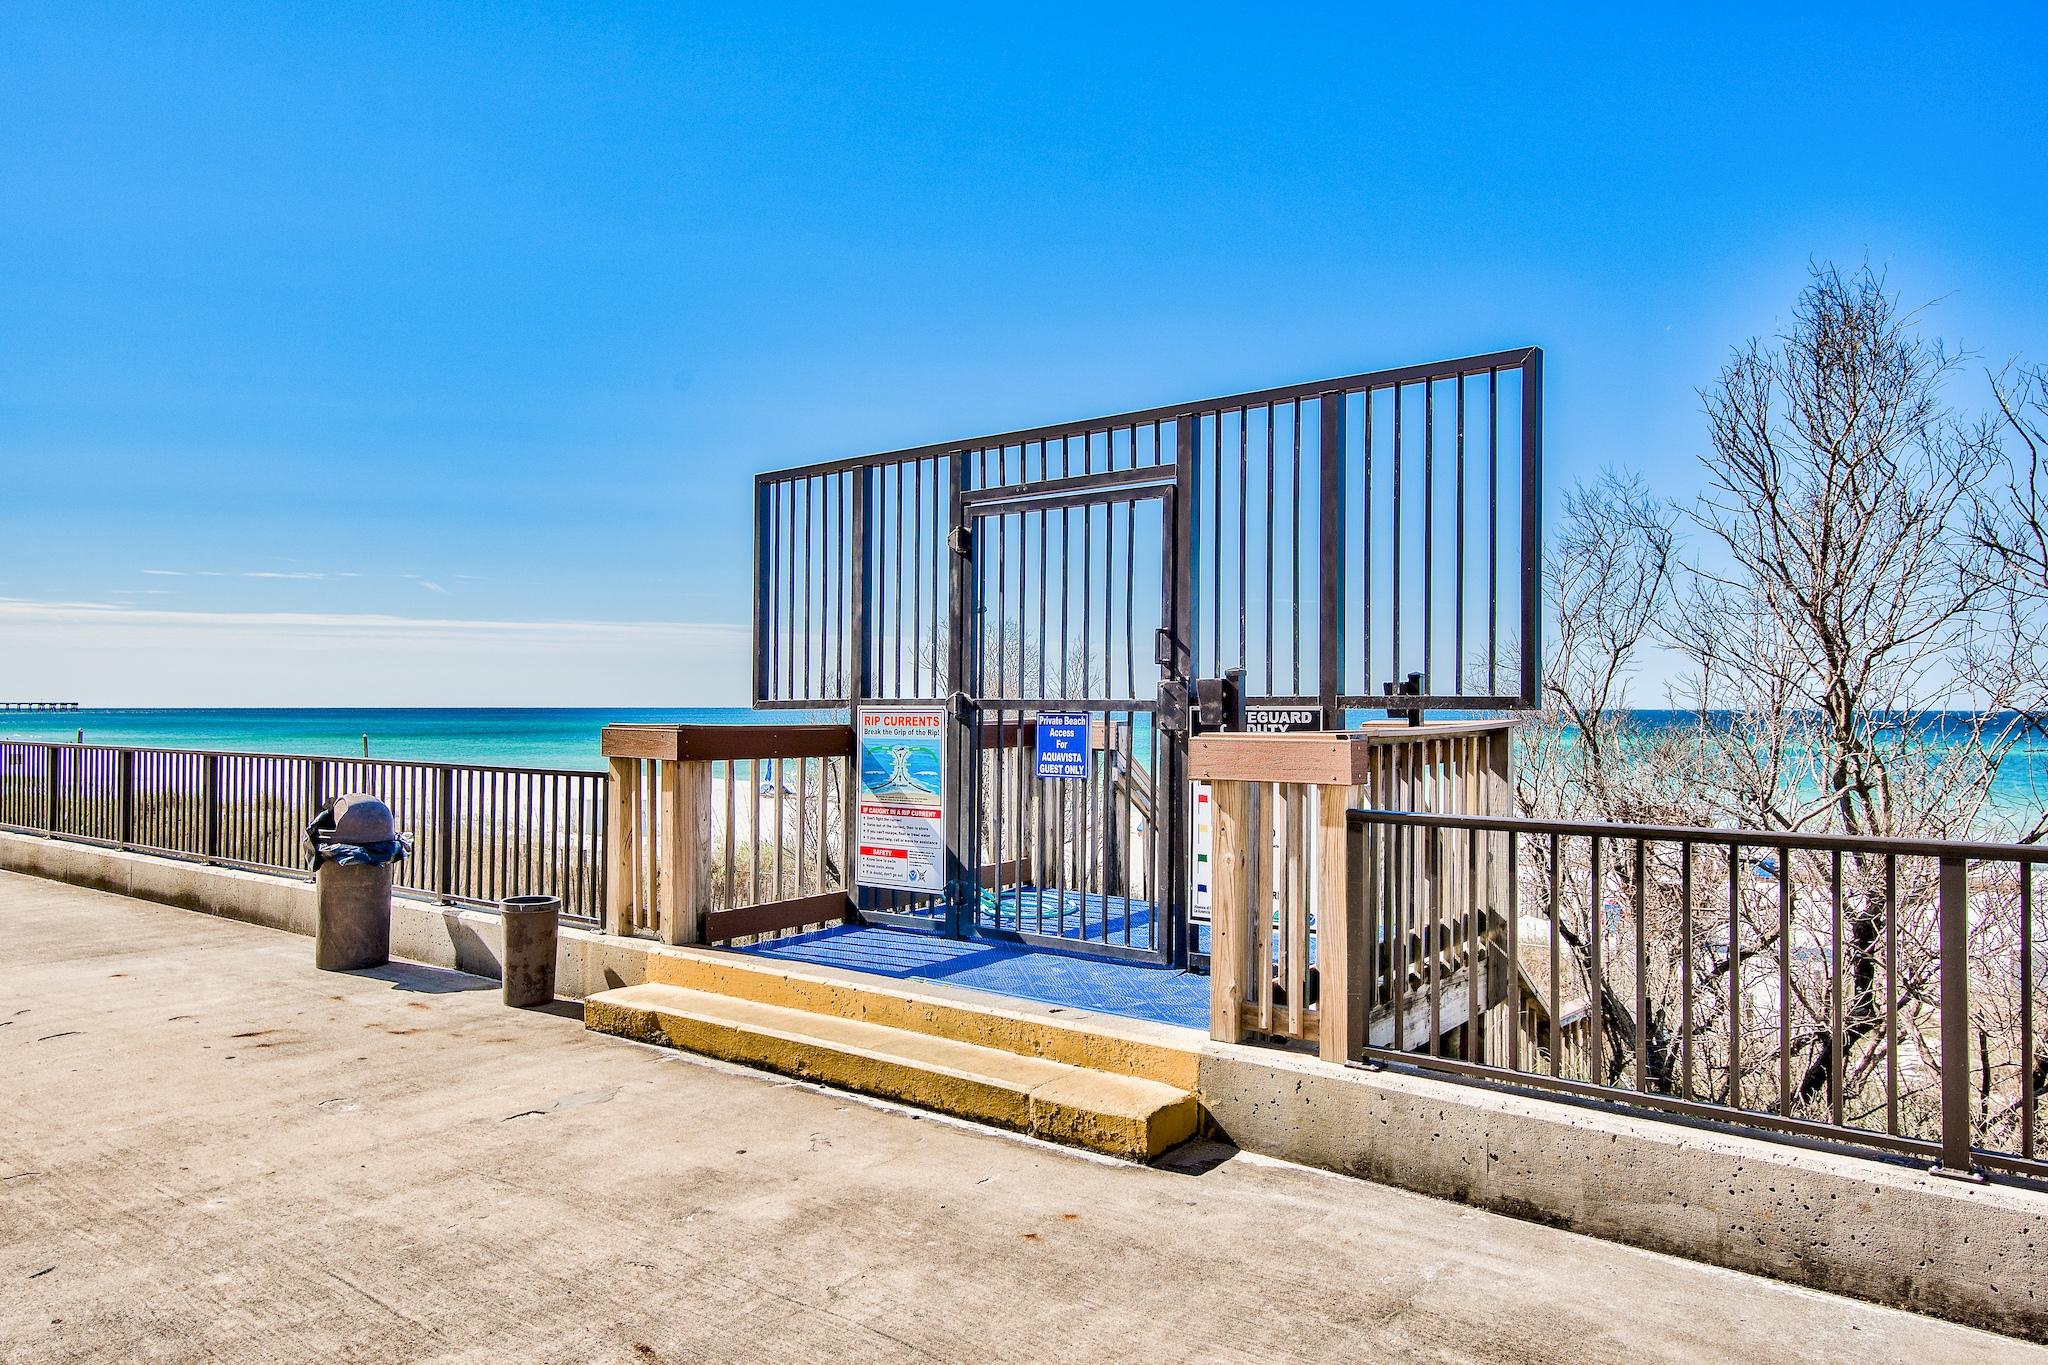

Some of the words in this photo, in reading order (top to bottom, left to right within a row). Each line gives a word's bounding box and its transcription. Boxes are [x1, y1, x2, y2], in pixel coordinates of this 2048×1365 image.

[864, 716, 880, 726] RIP
[884, 716, 940, 726] CURRENTS
[1040, 716, 1062, 725] Private
[1064, 716, 1086, 726] Beach
[1246, 712, 1312, 724] EGUARD
[1050, 728, 1074, 737] Access
[1247, 724, 1290, 732] DUTY
[1056, 740, 1068, 749] For
[1042, 752, 1082, 762] AQUAVISTA
[1040, 764, 1064, 774] GUEST
[1064, 765, 1084, 774] ONLY
